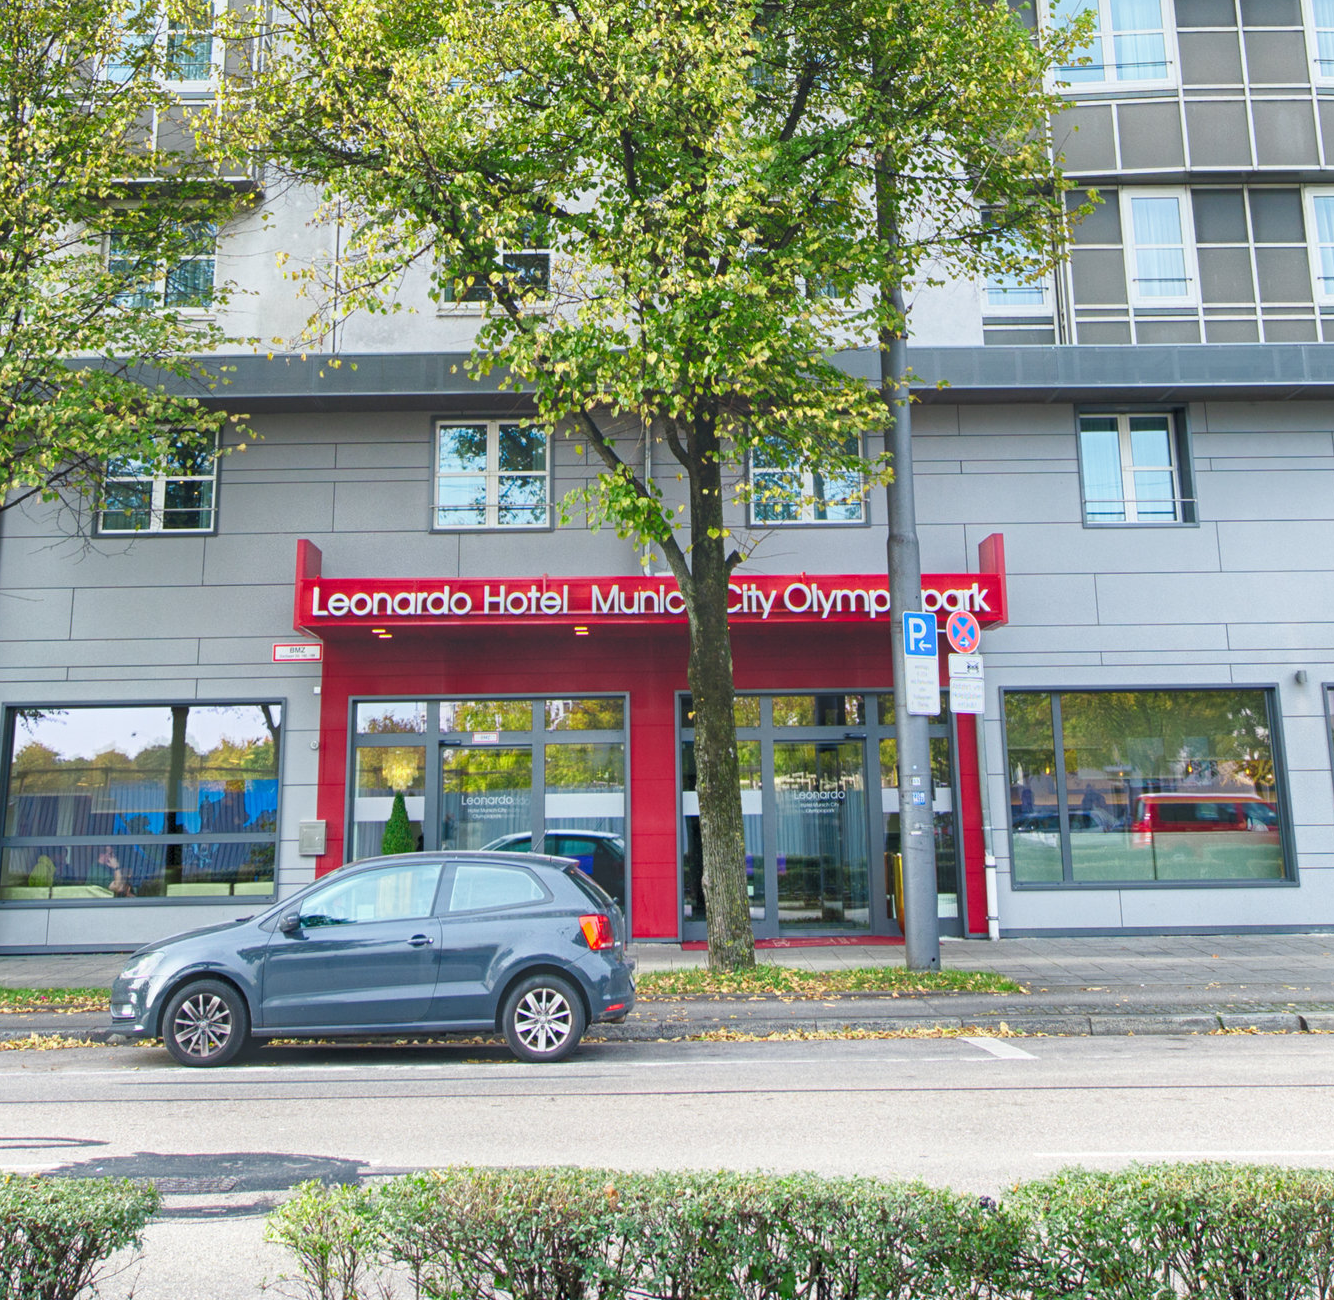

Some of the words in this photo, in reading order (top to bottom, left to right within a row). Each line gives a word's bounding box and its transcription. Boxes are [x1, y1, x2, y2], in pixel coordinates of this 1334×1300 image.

[312, 585, 473, 616] Leonardo
[483, 584, 569, 616] Hotel
[591, 584, 687, 615] Munic
[726, 583, 778, 620] City
[783, 582, 992, 619] Olymppark
[908, 617, 927, 651] P
[461, 794, 514, 806] Leonardo
[794, 790, 846, 800] Leonardo
